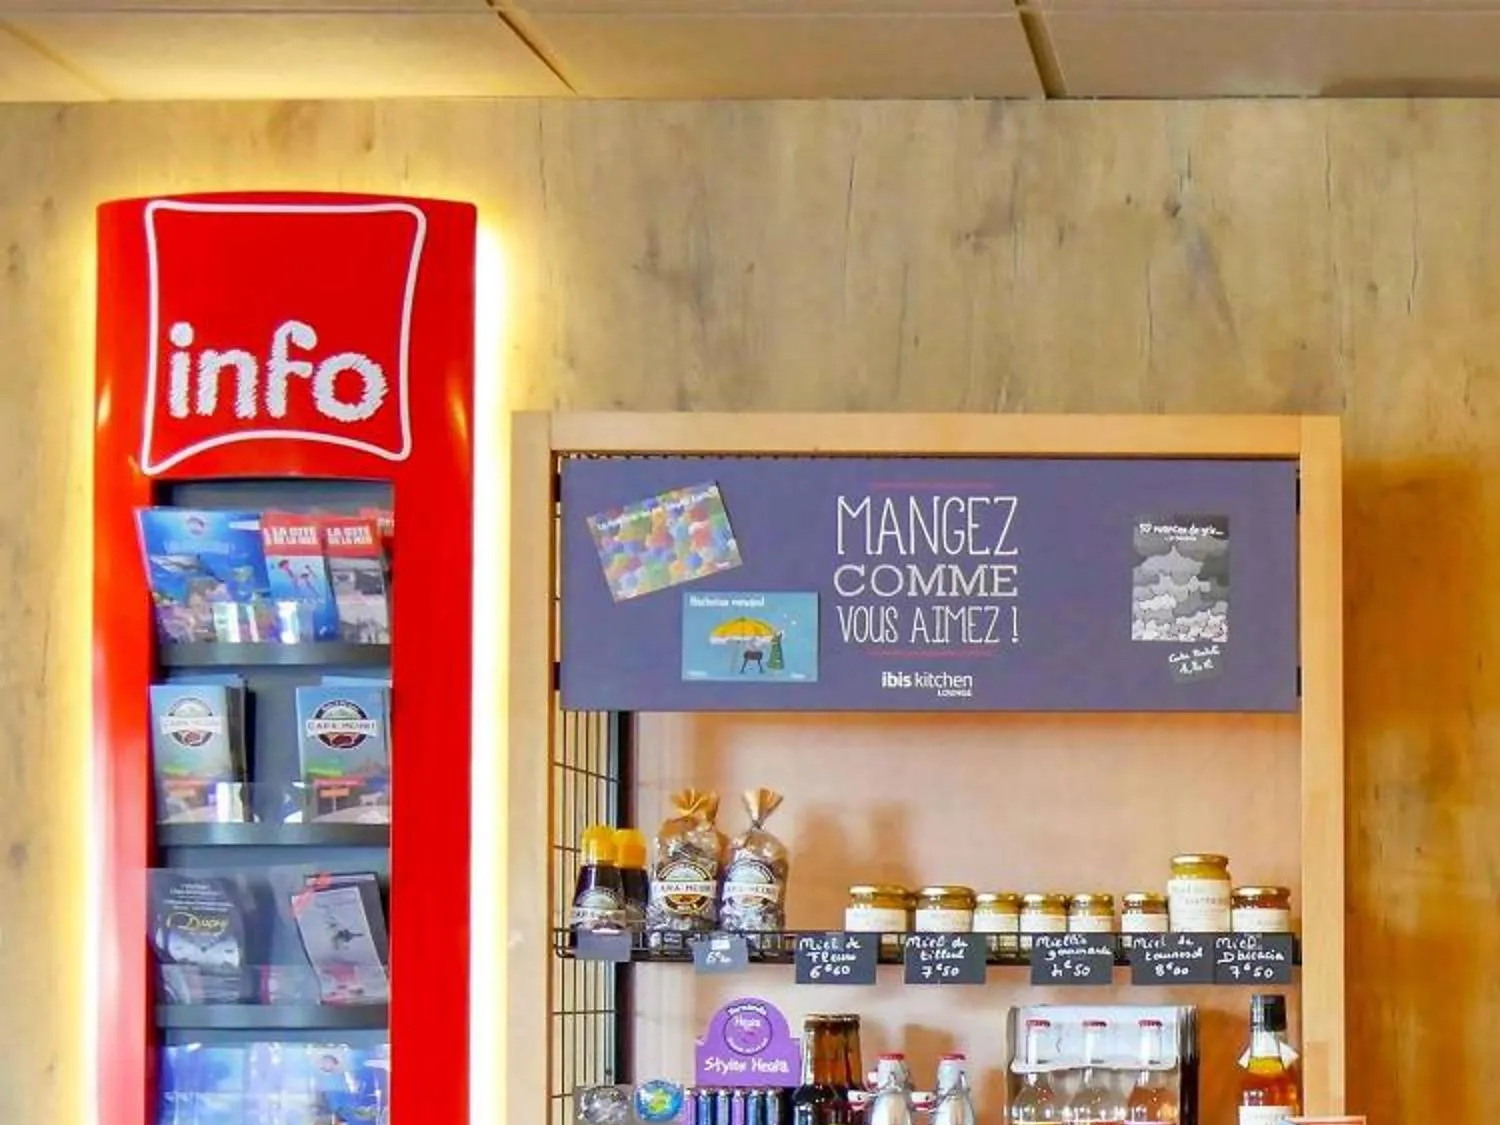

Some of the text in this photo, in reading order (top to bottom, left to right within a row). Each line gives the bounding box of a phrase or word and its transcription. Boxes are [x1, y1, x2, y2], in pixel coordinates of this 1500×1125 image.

[169, 320, 389, 422] info
[837, 495, 1019, 556] MANGEZ
[834, 564, 1018, 597] COMME
[836, 605, 1021, 643] VOUS AIMEZ !
[882, 671, 974, 688] ibis kitchen
